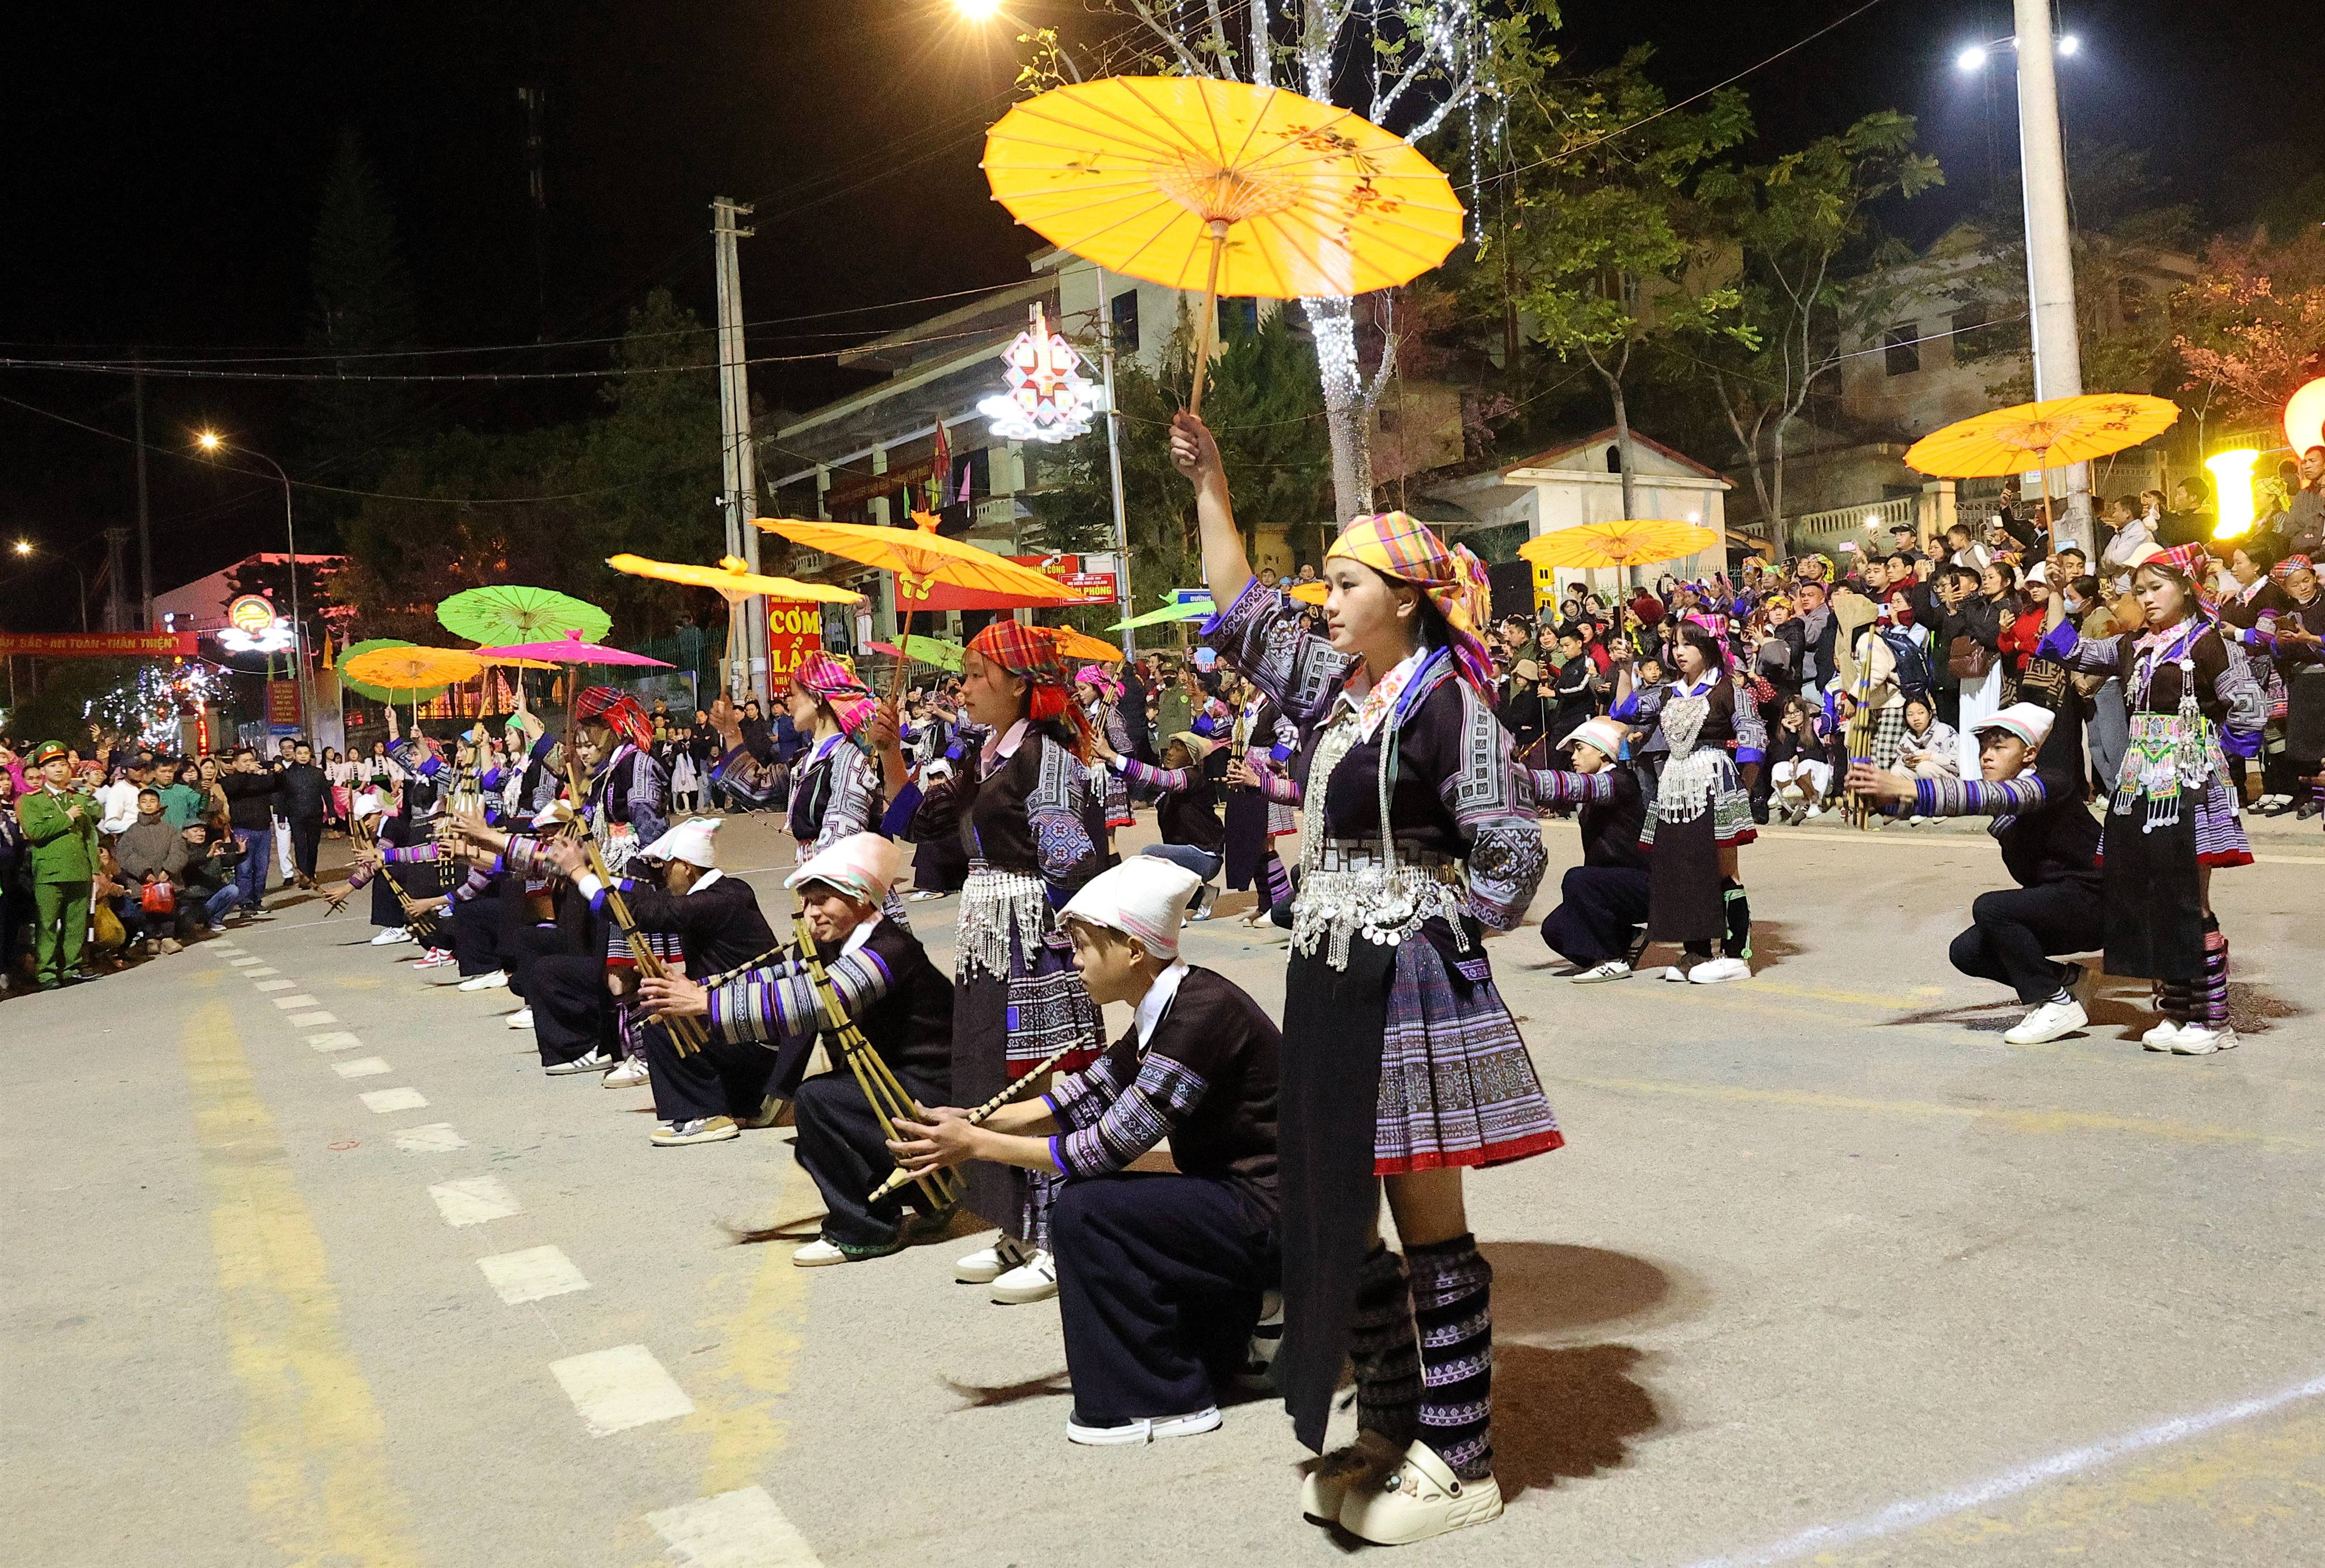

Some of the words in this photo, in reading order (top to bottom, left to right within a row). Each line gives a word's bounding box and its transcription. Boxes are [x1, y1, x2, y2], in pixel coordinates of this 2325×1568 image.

[1047, 564, 1065, 574] CÔNG
[1084, 585, 1111, 596] PHÒNG
[770, 606, 820, 634] CƠM
[771, 636, 813, 673] LẨ
